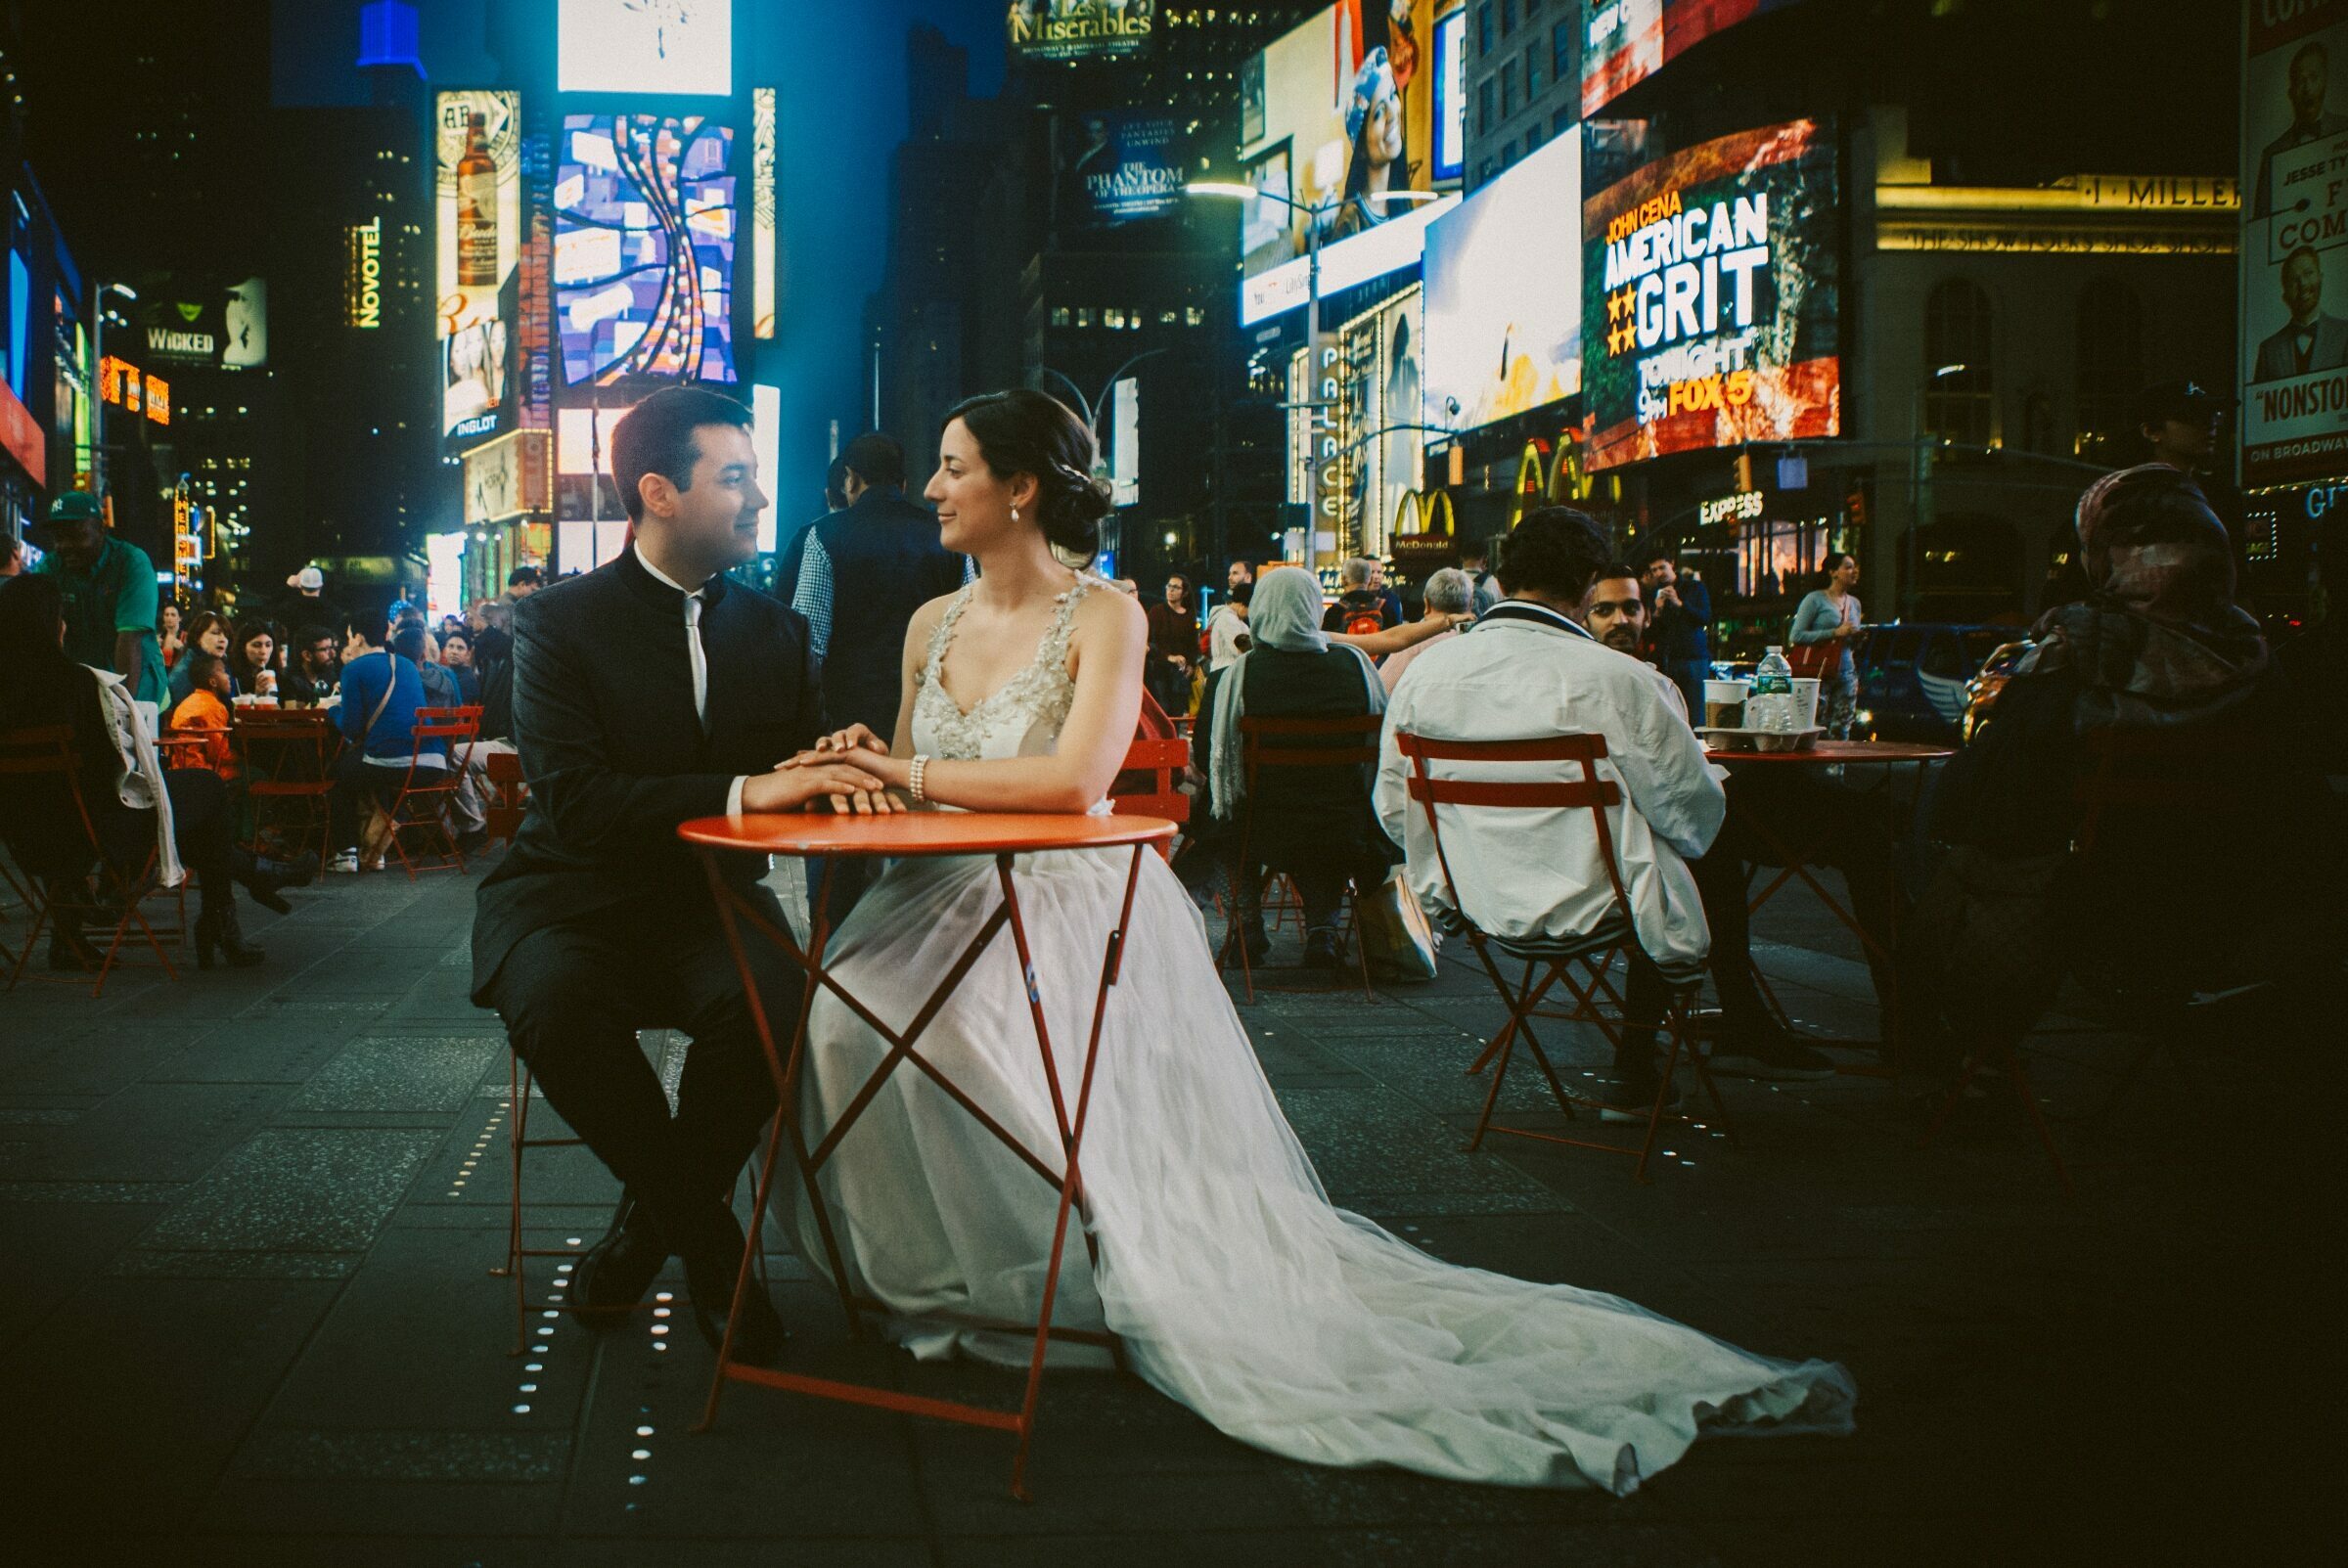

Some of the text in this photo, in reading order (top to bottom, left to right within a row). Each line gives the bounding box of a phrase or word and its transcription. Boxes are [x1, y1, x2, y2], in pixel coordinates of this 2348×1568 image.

[1087, 166, 1184, 191] PHANTOM
[2283, 161, 2326, 187] JESSE
[1604, 193, 1768, 292] AMERICAN
[1605, 191, 1683, 245] JOHN CENA
[359, 215, 381, 328] NOVOTEL
[1637, 246, 1769, 349] GRIT
[1639, 336, 1751, 390] TONIGHT
[1669, 373, 1724, 417] FOX
[1726, 369, 1754, 406] 5
[456, 415, 497, 437] INGLOT
[1322, 346, 1338, 516] PALACE
